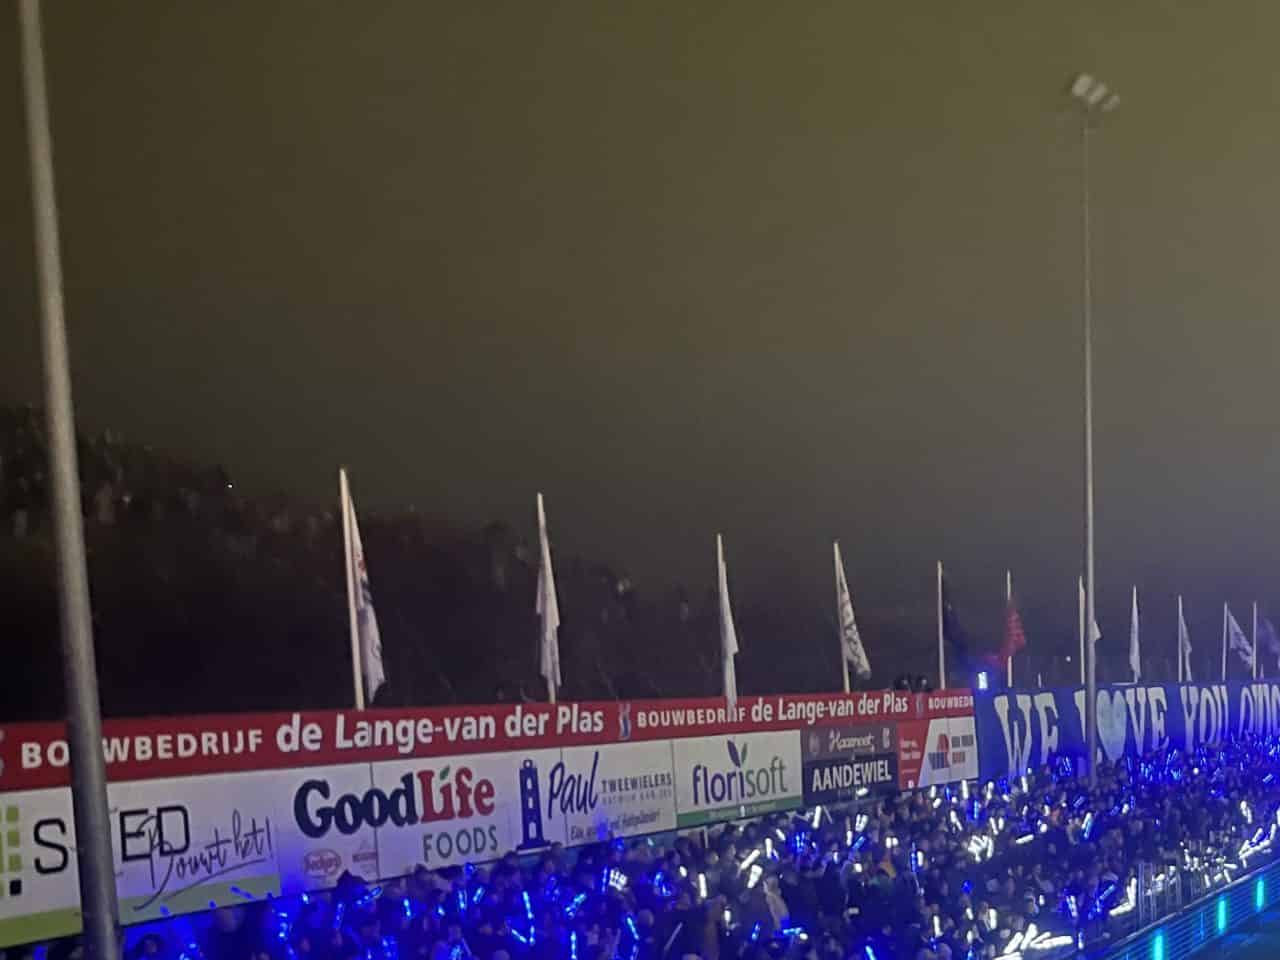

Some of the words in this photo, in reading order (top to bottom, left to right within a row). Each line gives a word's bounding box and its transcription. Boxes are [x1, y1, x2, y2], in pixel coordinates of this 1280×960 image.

[751, 697, 773, 722] de
[778, 697, 854, 725] Lange-van
[858, 694, 880, 716] der
[883, 693, 908, 713] Plas
[20, 728, 264, 769] BOWBEDRIJF
[276, 712, 322, 753] de
[335, 713, 496, 753] Lange-van
[505, 704, 549, 737] der
[557, 702, 604, 735] Plas
[548, 751, 599, 819] Paul
[601, 772, 672, 794] TWEEWIELERS
[692, 755, 788, 806] florisoft
[812, 760, 892, 792] AANDEWIEL
[294, 766, 496, 838] GoodLife
[33, 805, 191, 874] SED
[423, 825, 498, 862] FOODS
